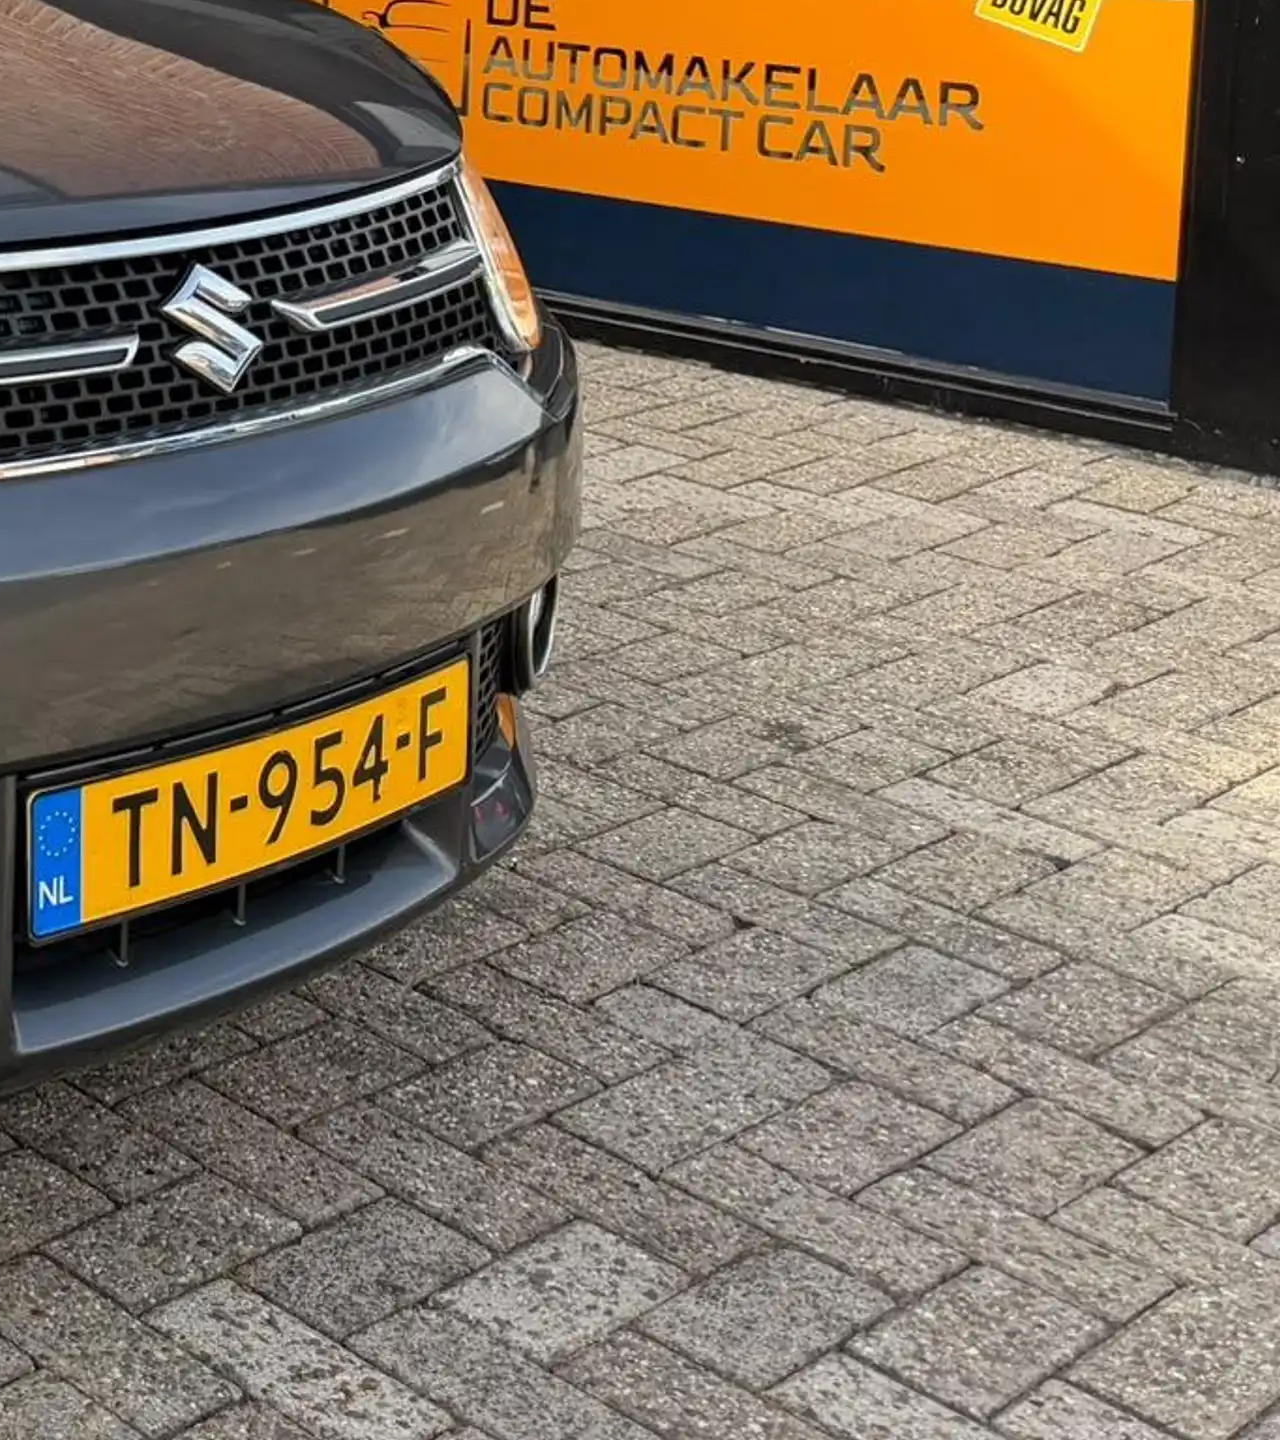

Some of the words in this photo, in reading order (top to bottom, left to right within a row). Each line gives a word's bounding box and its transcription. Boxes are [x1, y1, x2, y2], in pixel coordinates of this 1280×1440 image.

[483, 35, 984, 131] AUTOMAKELAAR
[483, 82, 745, 152] COMPACT
[756, 113, 886, 173] CAR
[111, 685, 448, 889] TN-954-F
[37, 874, 74, 910] NL
